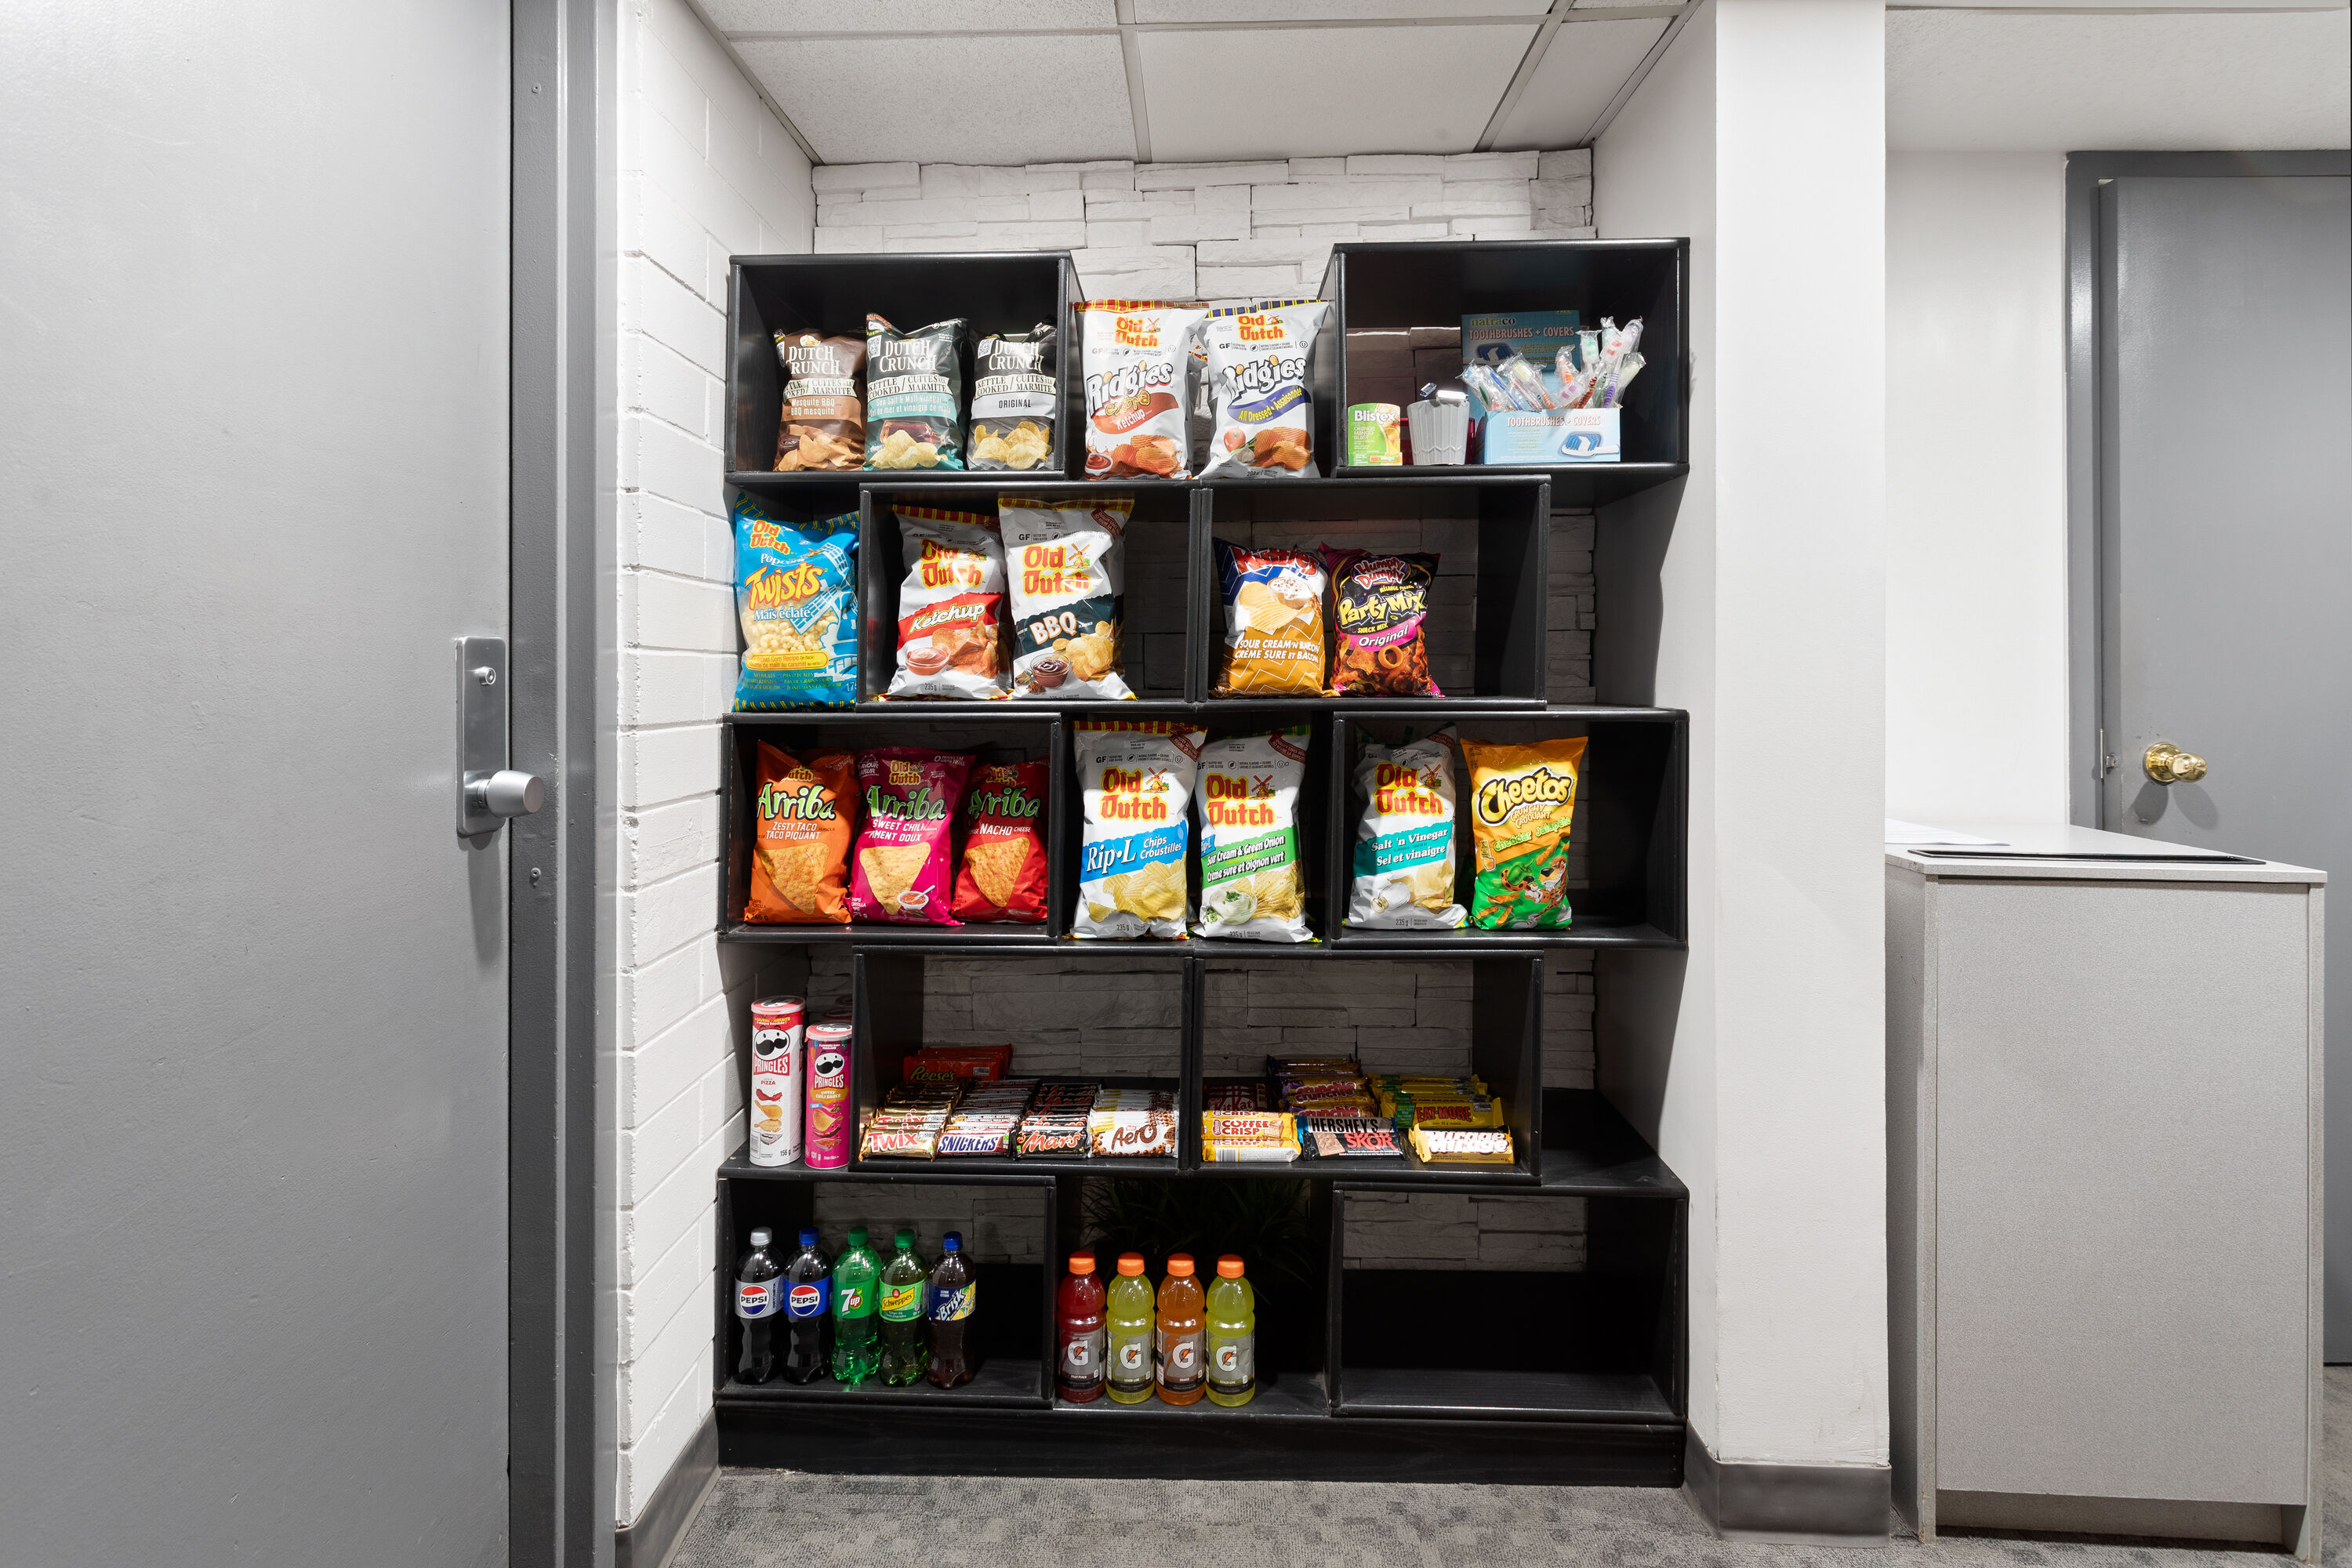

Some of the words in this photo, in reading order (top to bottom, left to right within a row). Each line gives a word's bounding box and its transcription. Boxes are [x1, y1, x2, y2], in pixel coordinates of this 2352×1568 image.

[1116, 316, 1144, 333] Old
[1238, 314, 1265, 326] Old
[1472, 317, 1515, 326] natraco
[1115, 329, 1159, 347] Dutch
[1240, 325, 1284, 341] Dutch
[1468, 328, 1534, 340] TOOTHBRUSHES
[1543, 326, 1575, 337] COVERS
[789, 346, 834, 361] DUTCH
[885, 339, 931, 358] DUTCH
[880, 355, 937, 372] CRUNCH
[989, 354, 1044, 372] CRUNCH
[869, 378, 897, 390] KETTLE
[908, 383, 946, 392] MARMITE
[978, 376, 1006, 387] KETTLE
[978, 384, 1008, 396] COOKED
[1016, 383, 1052, 392] MARMITE
[1087, 361, 1174, 419] Ridgies
[869, 386, 900, 399] COOKED
[887, 396, 898, 405] Salt
[906, 395, 917, 404] Malt
[791, 398, 819, 407] Mesquite
[822, 397, 834, 406] BBQ
[999, 399, 1032, 408] ORIGINAL
[1105, 390, 1150, 416] extra
[1239, 410, 1247, 422] All
[1248, 407, 1273, 422] Dressed
[1272, 387, 1302, 411] Assaisonnée
[791, 407, 802, 416] BBQ
[1116, 408, 1145, 430] Ketchup
[1354, 409, 1396, 425] Blistex
[1507, 416, 1564, 427] TOOTHBRUSHES
[1573, 416, 1601, 426] COVERS
[753, 520, 779, 537] Old
[750, 533, 790, 555] Dutch
[921, 539, 960, 561] Old
[760, 554, 805, 566] Popcorn
[1023, 546, 1065, 569] Old
[1355, 557, 1406, 576] Humpty
[921, 562, 983, 589] Dutch
[1023, 569, 1091, 595] Dutch
[1355, 568, 1406, 590] Dumpty
[745, 561, 825, 610] Twists
[754, 608, 777, 621] Maïs
[1339, 595, 1387, 626] Party
[1385, 590, 1425, 613] Mix
[909, 603, 986, 634] Ketchup
[1377, 622, 1388, 631] MIX
[1029, 611, 1077, 645] BBQ
[1359, 624, 1409, 647] Original
[1234, 648, 1261, 659] CRÈME
[1264, 649, 1287, 659] SURE
[1296, 652, 1319, 663] BACON
[1239, 639, 1261, 649] SOUR
[1299, 641, 1321, 654] BACON
[787, 769, 813, 780] utch
[891, 760, 909, 773] Old
[890, 772, 921, 785] Dutch
[1103, 768, 1142, 793] Old
[1376, 763, 1417, 789] Old
[1207, 774, 1247, 800] Old
[1480, 768, 1573, 824] Cheetos
[757, 782, 837, 820] Arriba
[866, 785, 948, 821] Arriba
[1101, 794, 1167, 820] Dutch
[1375, 789, 1443, 815] Dutch
[1207, 800, 1274, 826] Dutch
[1510, 804, 1546, 822] CRUNCHY
[1515, 811, 1552, 829] CROQUANT
[772, 822, 795, 831] ZESTY
[797, 822, 817, 831] TACO
[873, 820, 902, 831] SWEET
[902, 823, 924, 832] CHILI
[979, 823, 1013, 836] NACHO
[1494, 830, 1533, 852] Cheddar
[1534, 816, 1572, 837] Jalapeño
[766, 831, 784, 840] TACO
[785, 831, 821, 840] PIQUANT
[898, 833, 922, 842] DOUX
[1143, 836, 1167, 849] Chips
[1371, 840, 1392, 851] Salt
[1396, 837, 1406, 846] 'n
[1408, 829, 1449, 844] Vinegar
[1140, 842, 1182, 860] Croustilles
[1217, 848, 1237, 862] Cream
[1237, 845, 1243, 857] &
[1243, 840, 1263, 855] Green
[1264, 835, 1286, 848] Onion
[1376, 855, 1392, 866] Sel
[1392, 852, 1404, 862] et
[1405, 845, 1446, 861] vinaigre
[1207, 870, 1222, 883] Crème
[1222, 864, 1238, 877] sure
[1237, 862, 1245, 873] et
[1245, 857, 1270, 873] oignon
[1270, 850, 1286, 864] vert
[753, 1055, 789, 1075] PRINGLES
[909, 1065, 956, 1082] Reese's
[814, 1073, 844, 1088] PRINGLES
[1207, 1093, 1254, 1112] KitKat
[1416, 1106, 1472, 1123] EAT-MORE
[1221, 1120, 1269, 1128] COFFEE
[1311, 1118, 1379, 1133] HERSHEY'S
[868, 1130, 918, 1153] Twix
[939, 1134, 999, 1153] SNICKERS
[1021, 1130, 1081, 1154] Mars
[1111, 1125, 1158, 1150] Aero
[1347, 1137, 1398, 1151] SKOR
[741, 1295, 768, 1304] PEPSI
[791, 1295, 818, 1304] PEPSI
[883, 1293, 913, 1309] Schweppes
[939, 1288, 965, 1321] Brisk
[1067, 1340, 1091, 1367] G
[1120, 1342, 1142, 1370] G
[1172, 1341, 1195, 1369] G
[1216, 1345, 1238, 1372] G
